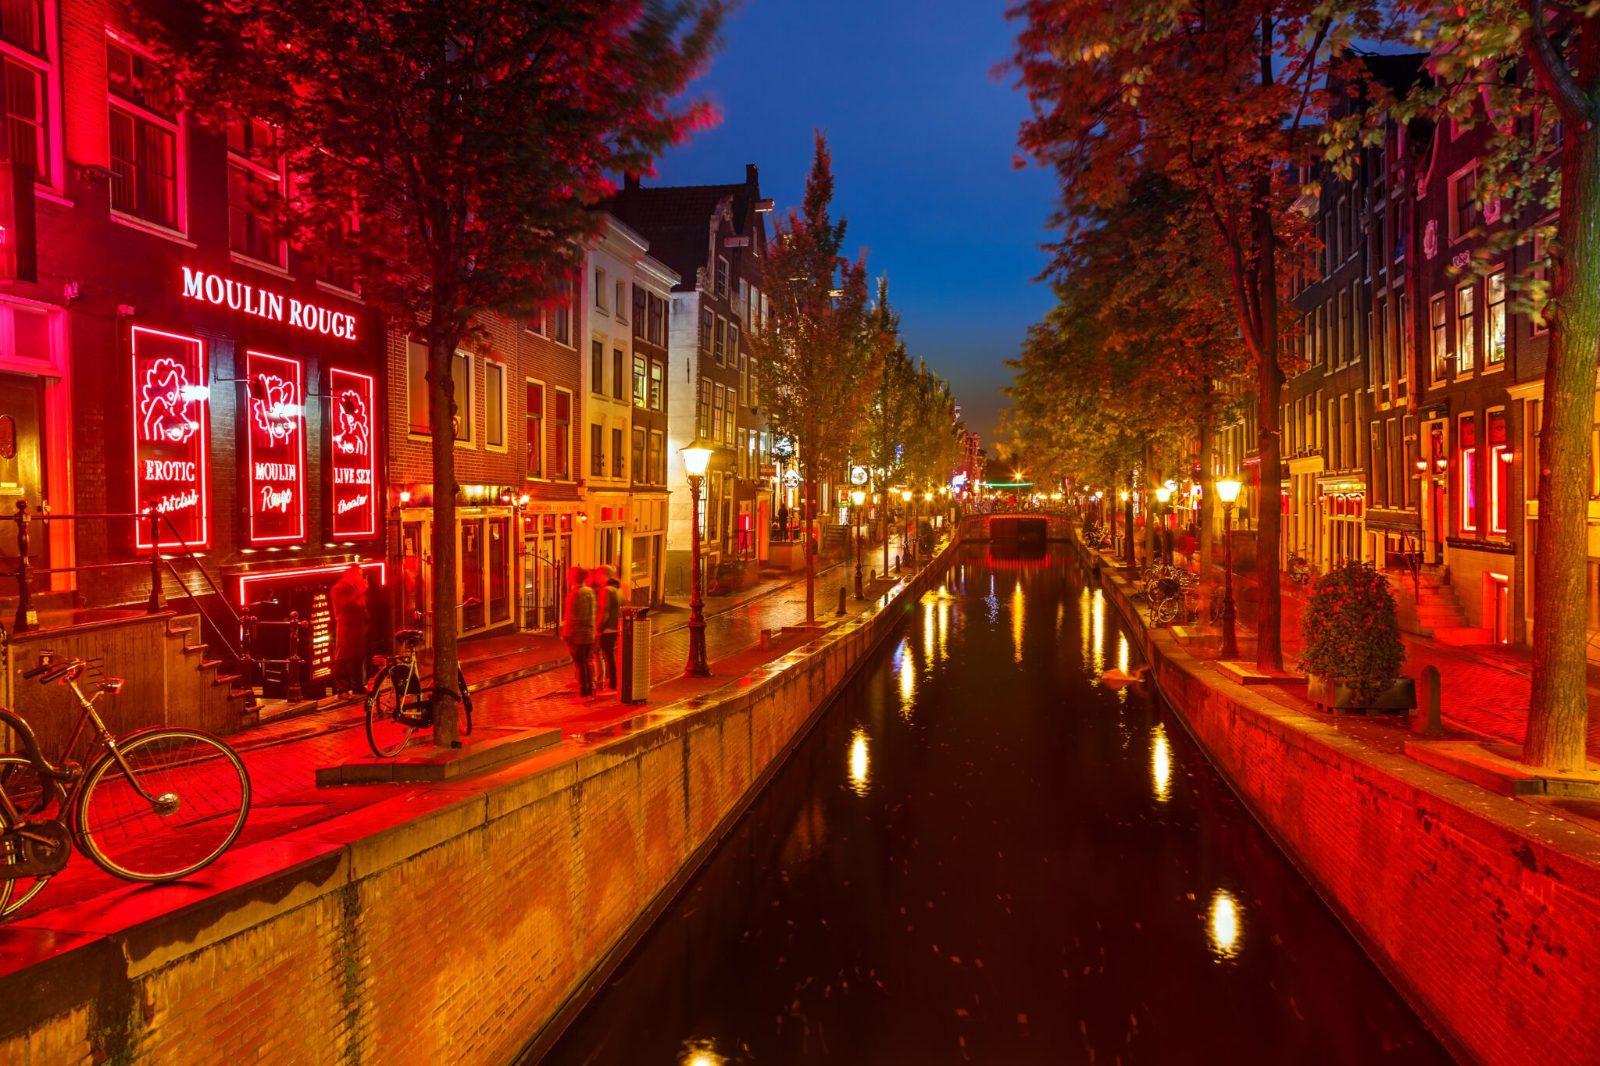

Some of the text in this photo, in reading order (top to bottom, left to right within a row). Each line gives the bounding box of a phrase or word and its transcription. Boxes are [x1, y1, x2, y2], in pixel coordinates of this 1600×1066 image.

[182, 267, 356, 340] MOULIN ROUGE
[145, 460, 195, 482] EROTIC
[254, 462, 296, 481] MOULIN
[334, 467, 371, 485] LIVE SEX
[141, 489, 199, 520] htclub
